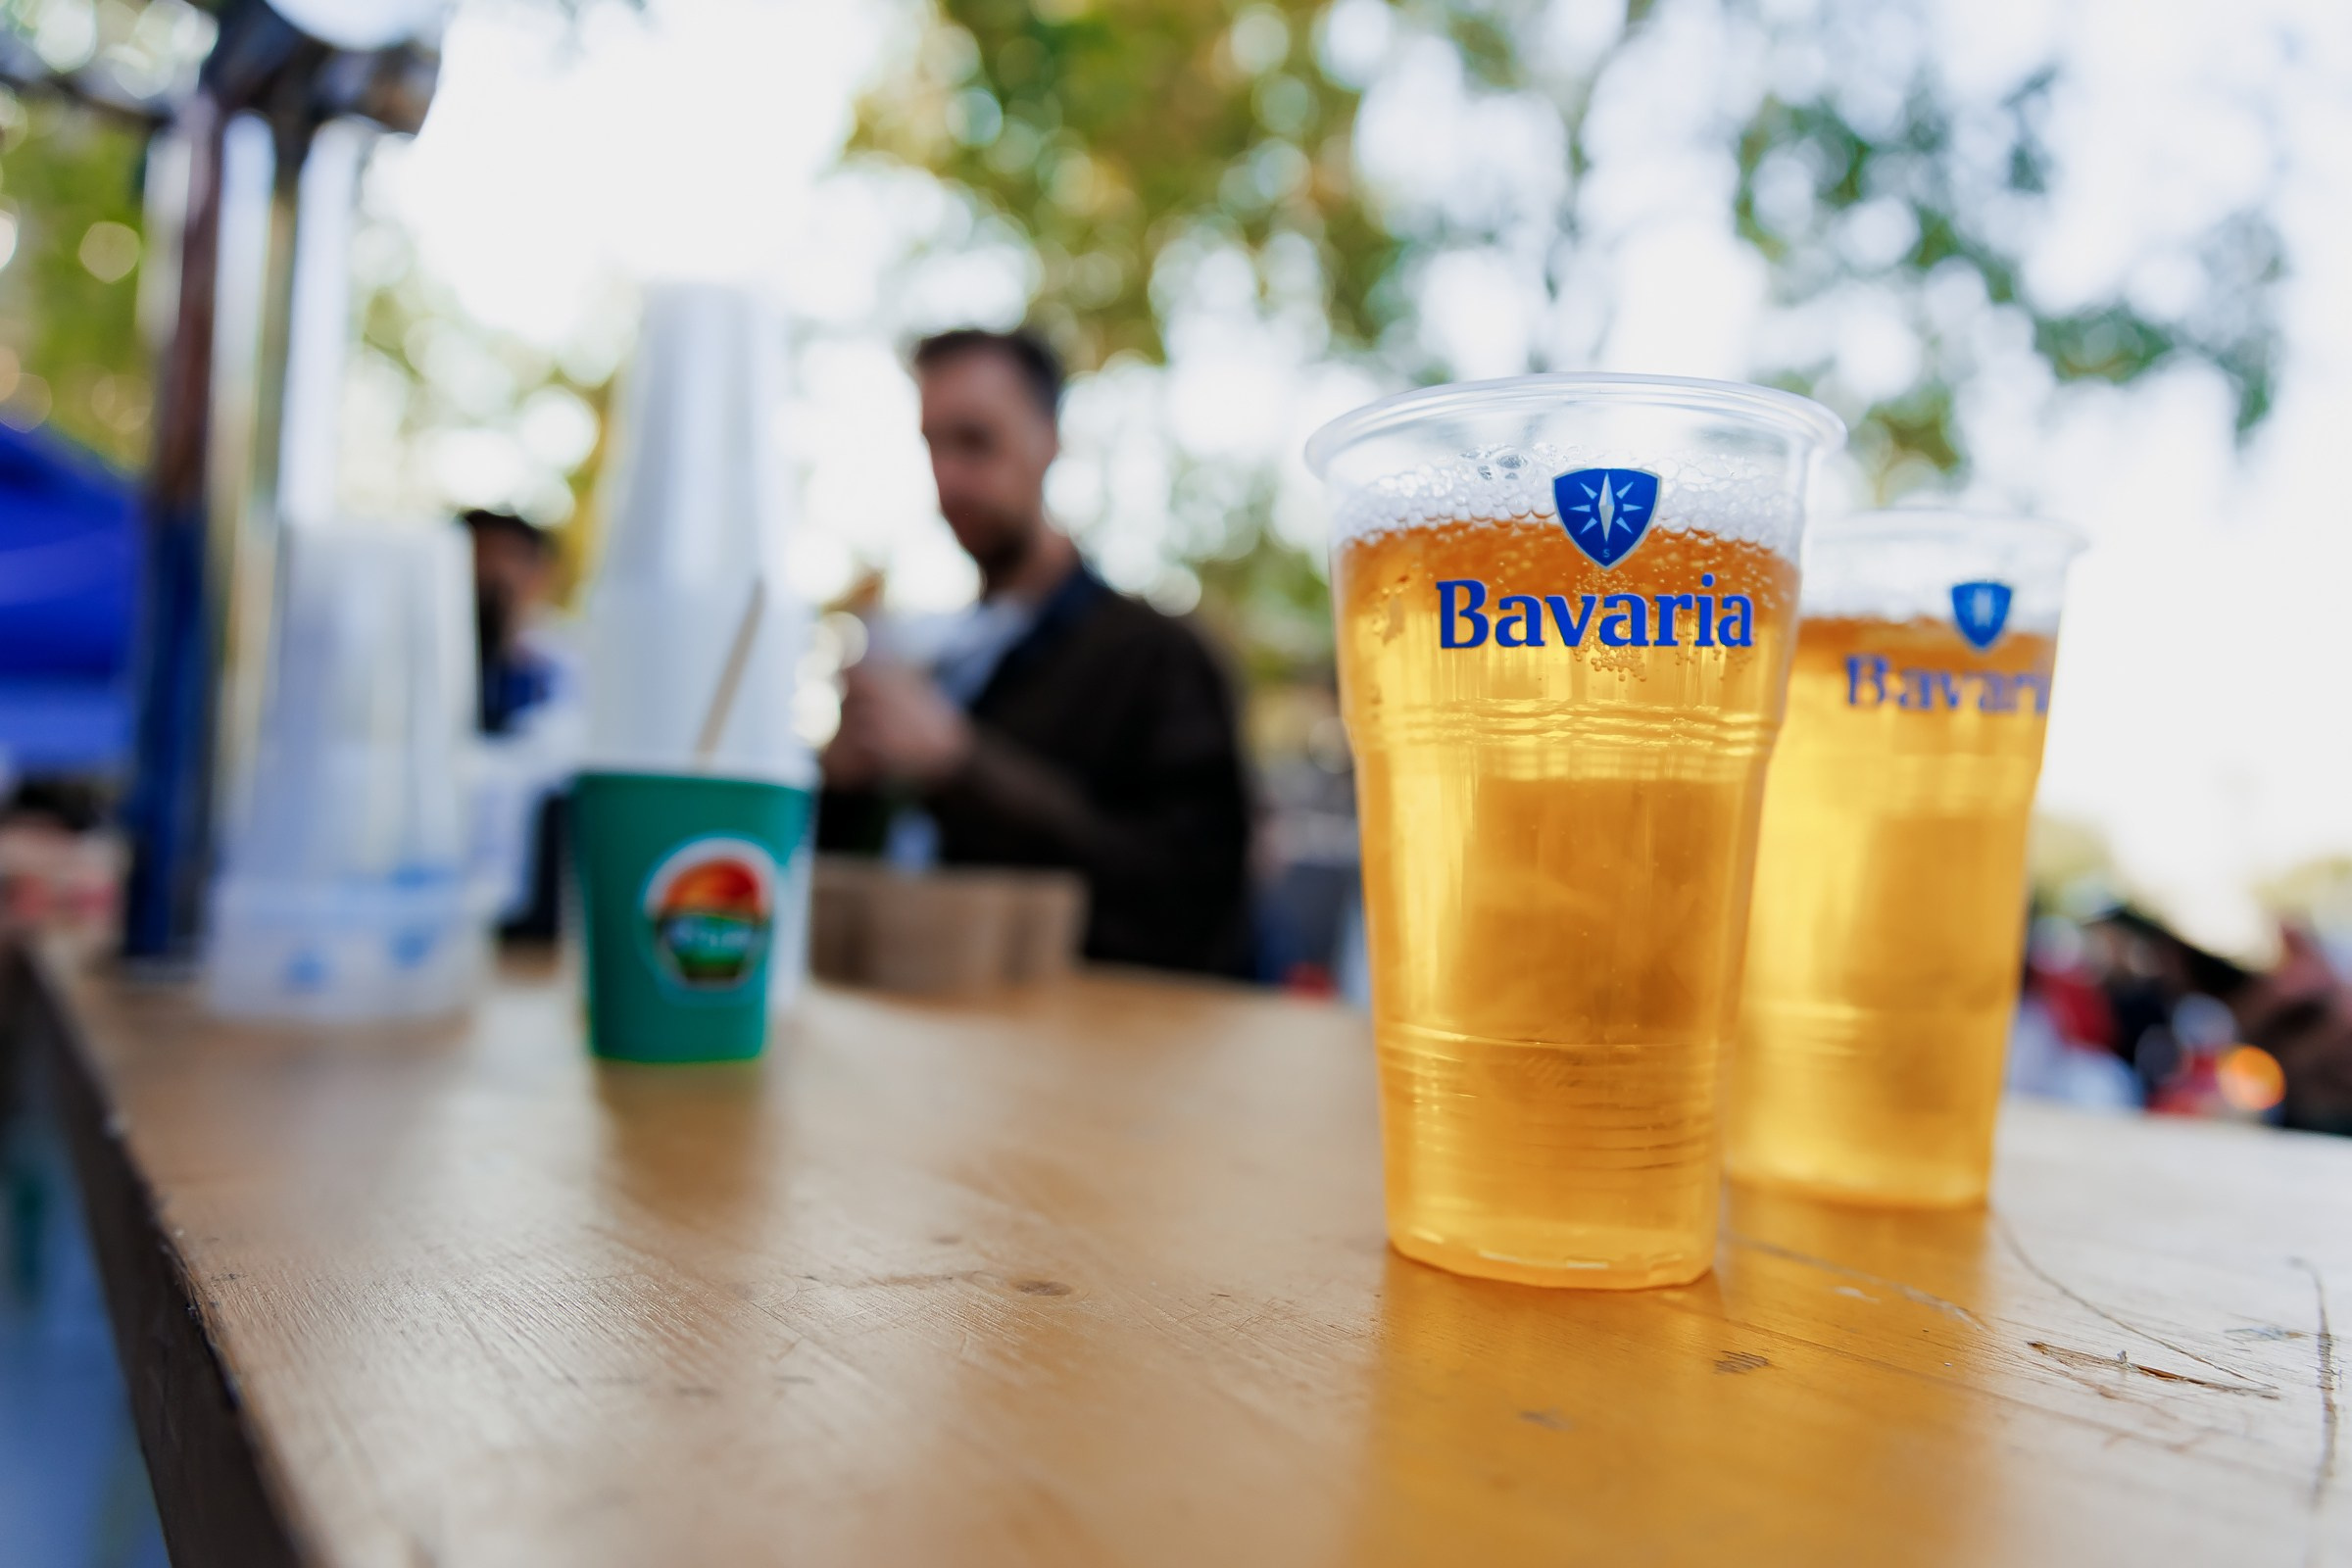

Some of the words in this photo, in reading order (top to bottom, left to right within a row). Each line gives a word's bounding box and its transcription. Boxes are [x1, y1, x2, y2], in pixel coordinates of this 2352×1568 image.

[1602, 549, 1610, 558] S
[1436, 572, 1754, 649] Bavaria
[1845, 654, 2049, 714] Bavari
